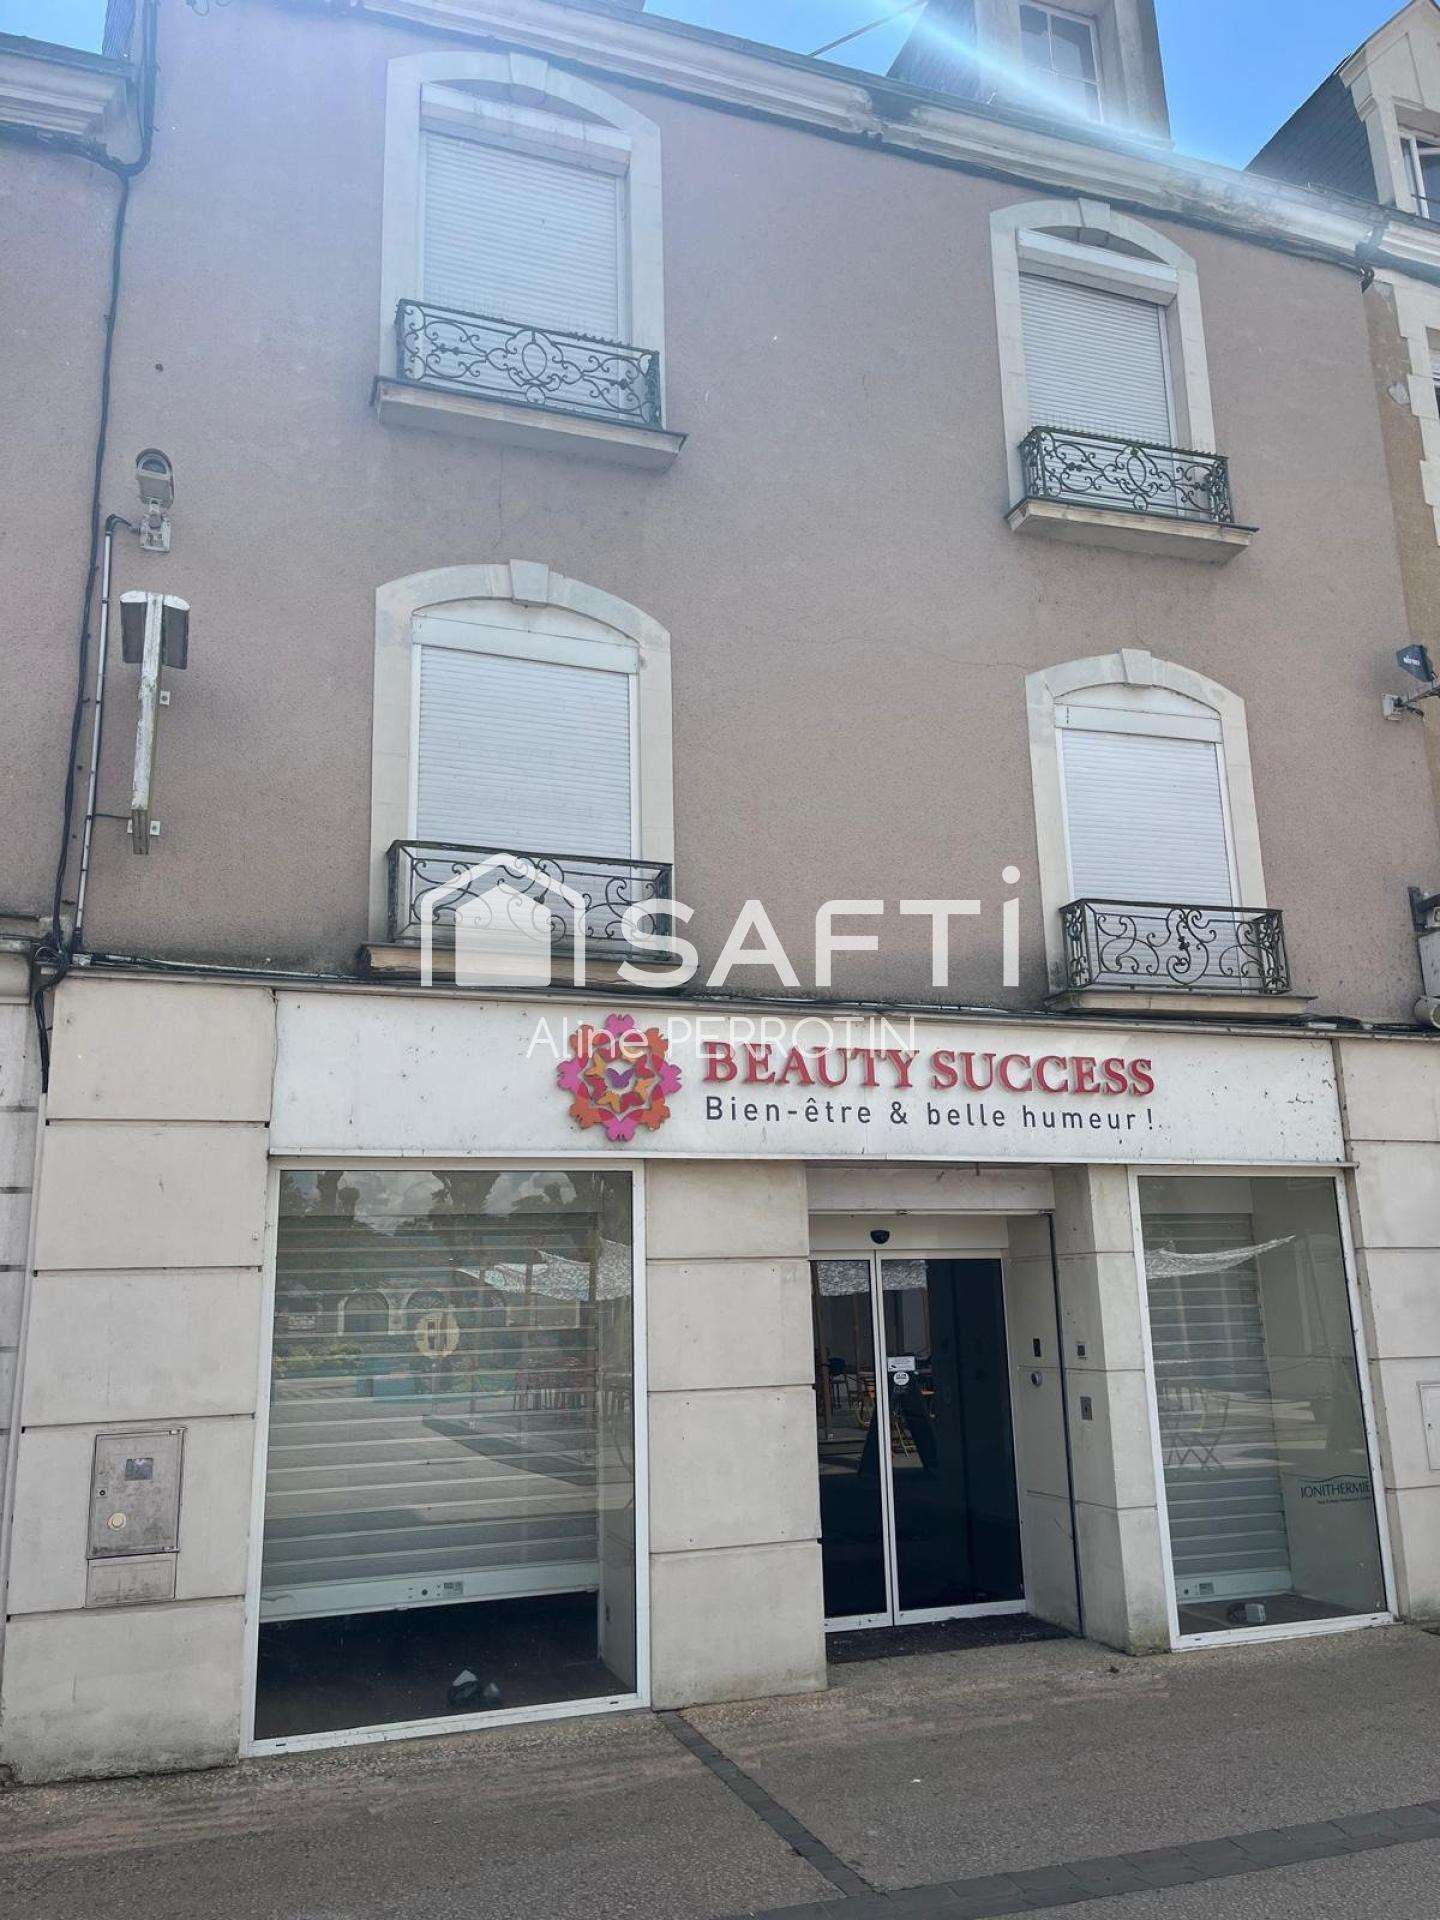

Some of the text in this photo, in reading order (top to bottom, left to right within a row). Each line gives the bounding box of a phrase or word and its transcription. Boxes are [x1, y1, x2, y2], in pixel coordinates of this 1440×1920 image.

[703, 1041, 1155, 1097] BEAUTY SUCCESS
[705, 1096, 872, 1124] Bien-être
[890, 1101, 908, 1125] &
[927, 1102, 1006, 1127] belle
